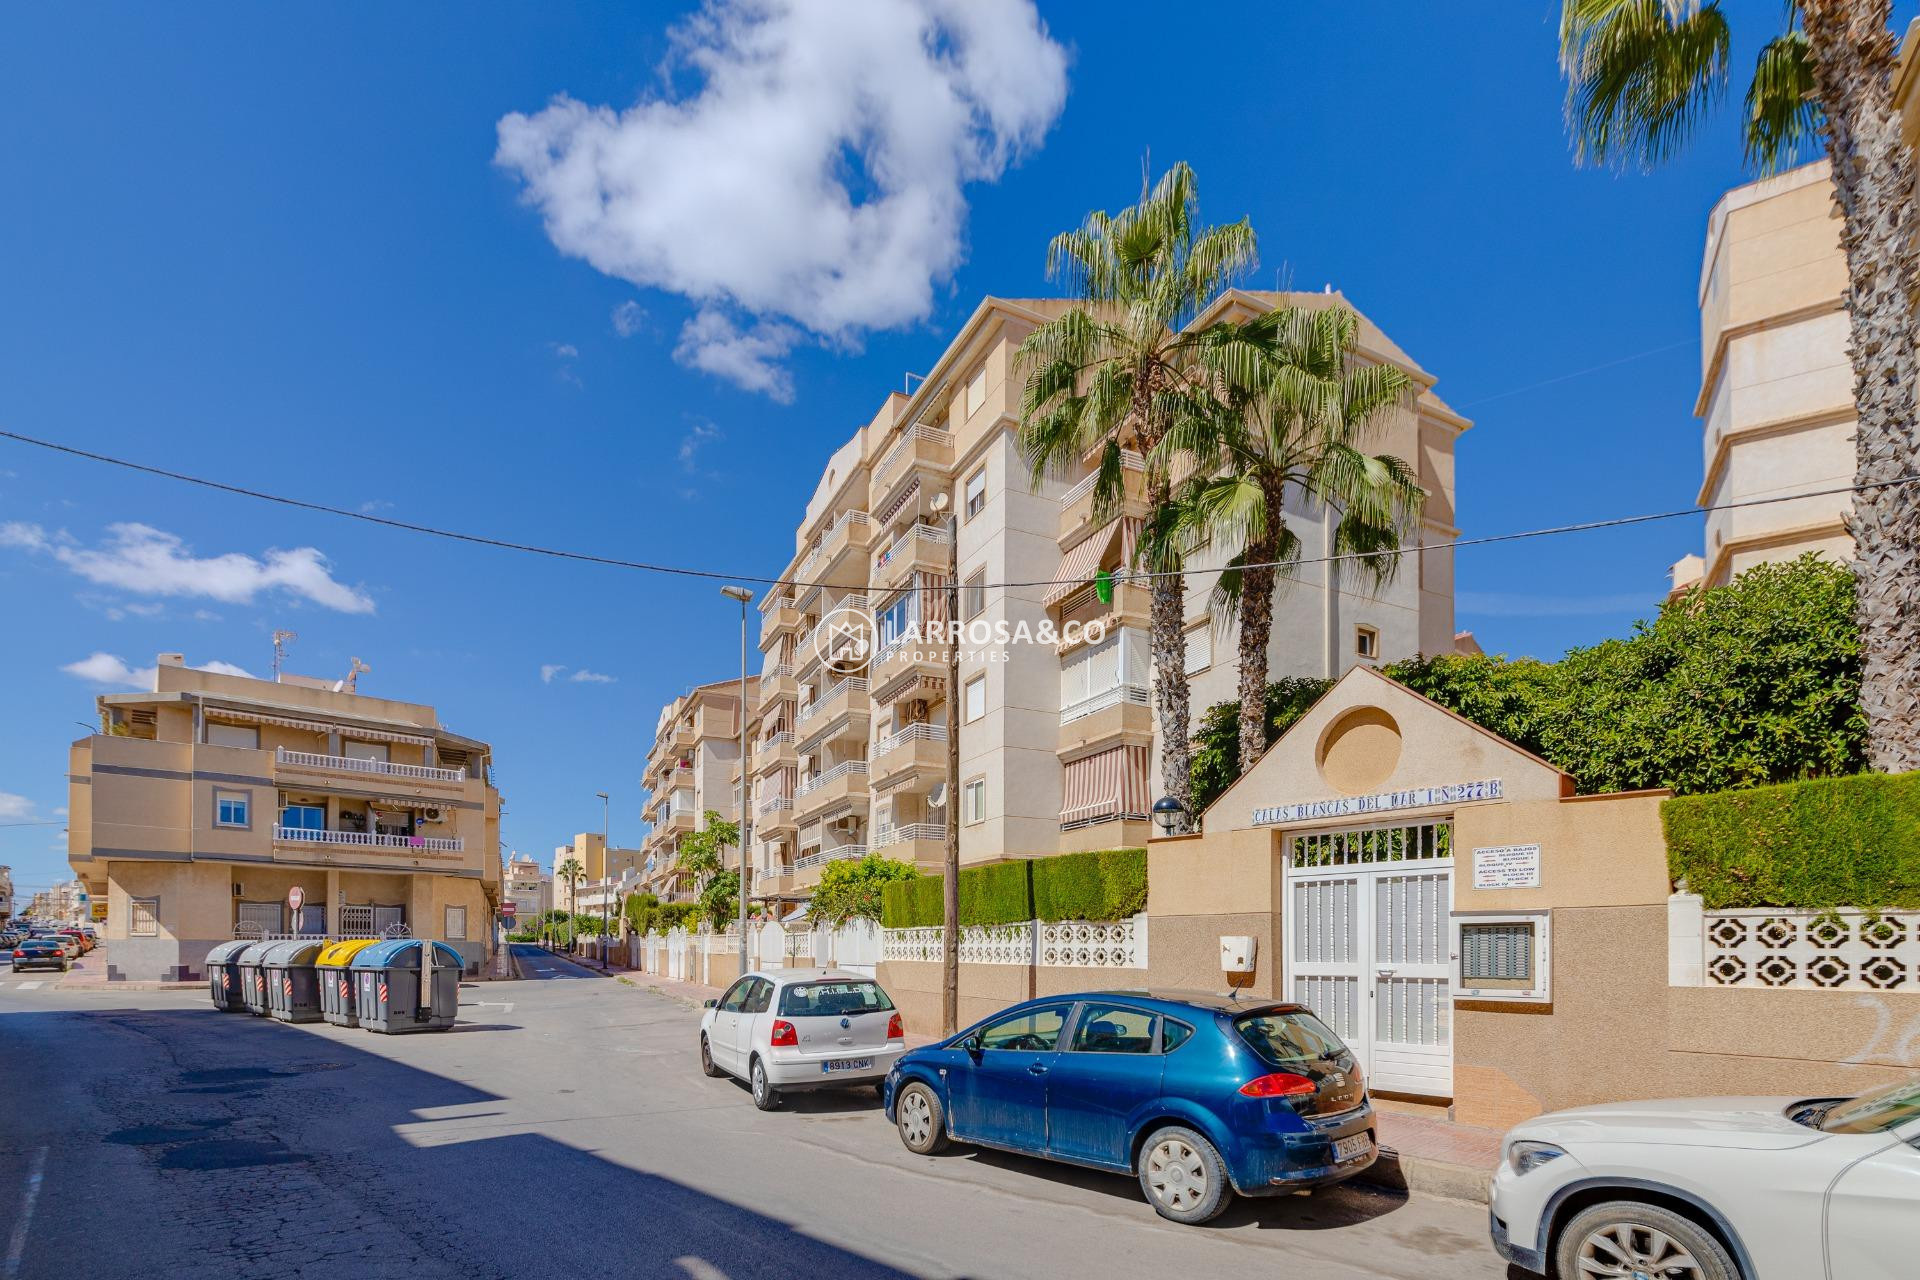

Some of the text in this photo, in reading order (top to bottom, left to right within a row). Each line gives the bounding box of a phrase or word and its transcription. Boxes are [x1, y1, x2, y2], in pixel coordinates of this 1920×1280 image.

[1254, 808, 1289, 822] CALAS
[1297, 800, 1349, 818] BLANCAS
[1358, 796, 1382, 811] DEL
[1391, 793, 1416, 807] MAR
[1458, 784, 1484, 798] 277
[1490, 782, 1499, 795] B
[829, 1058, 869, 1070] 8913 CNK
